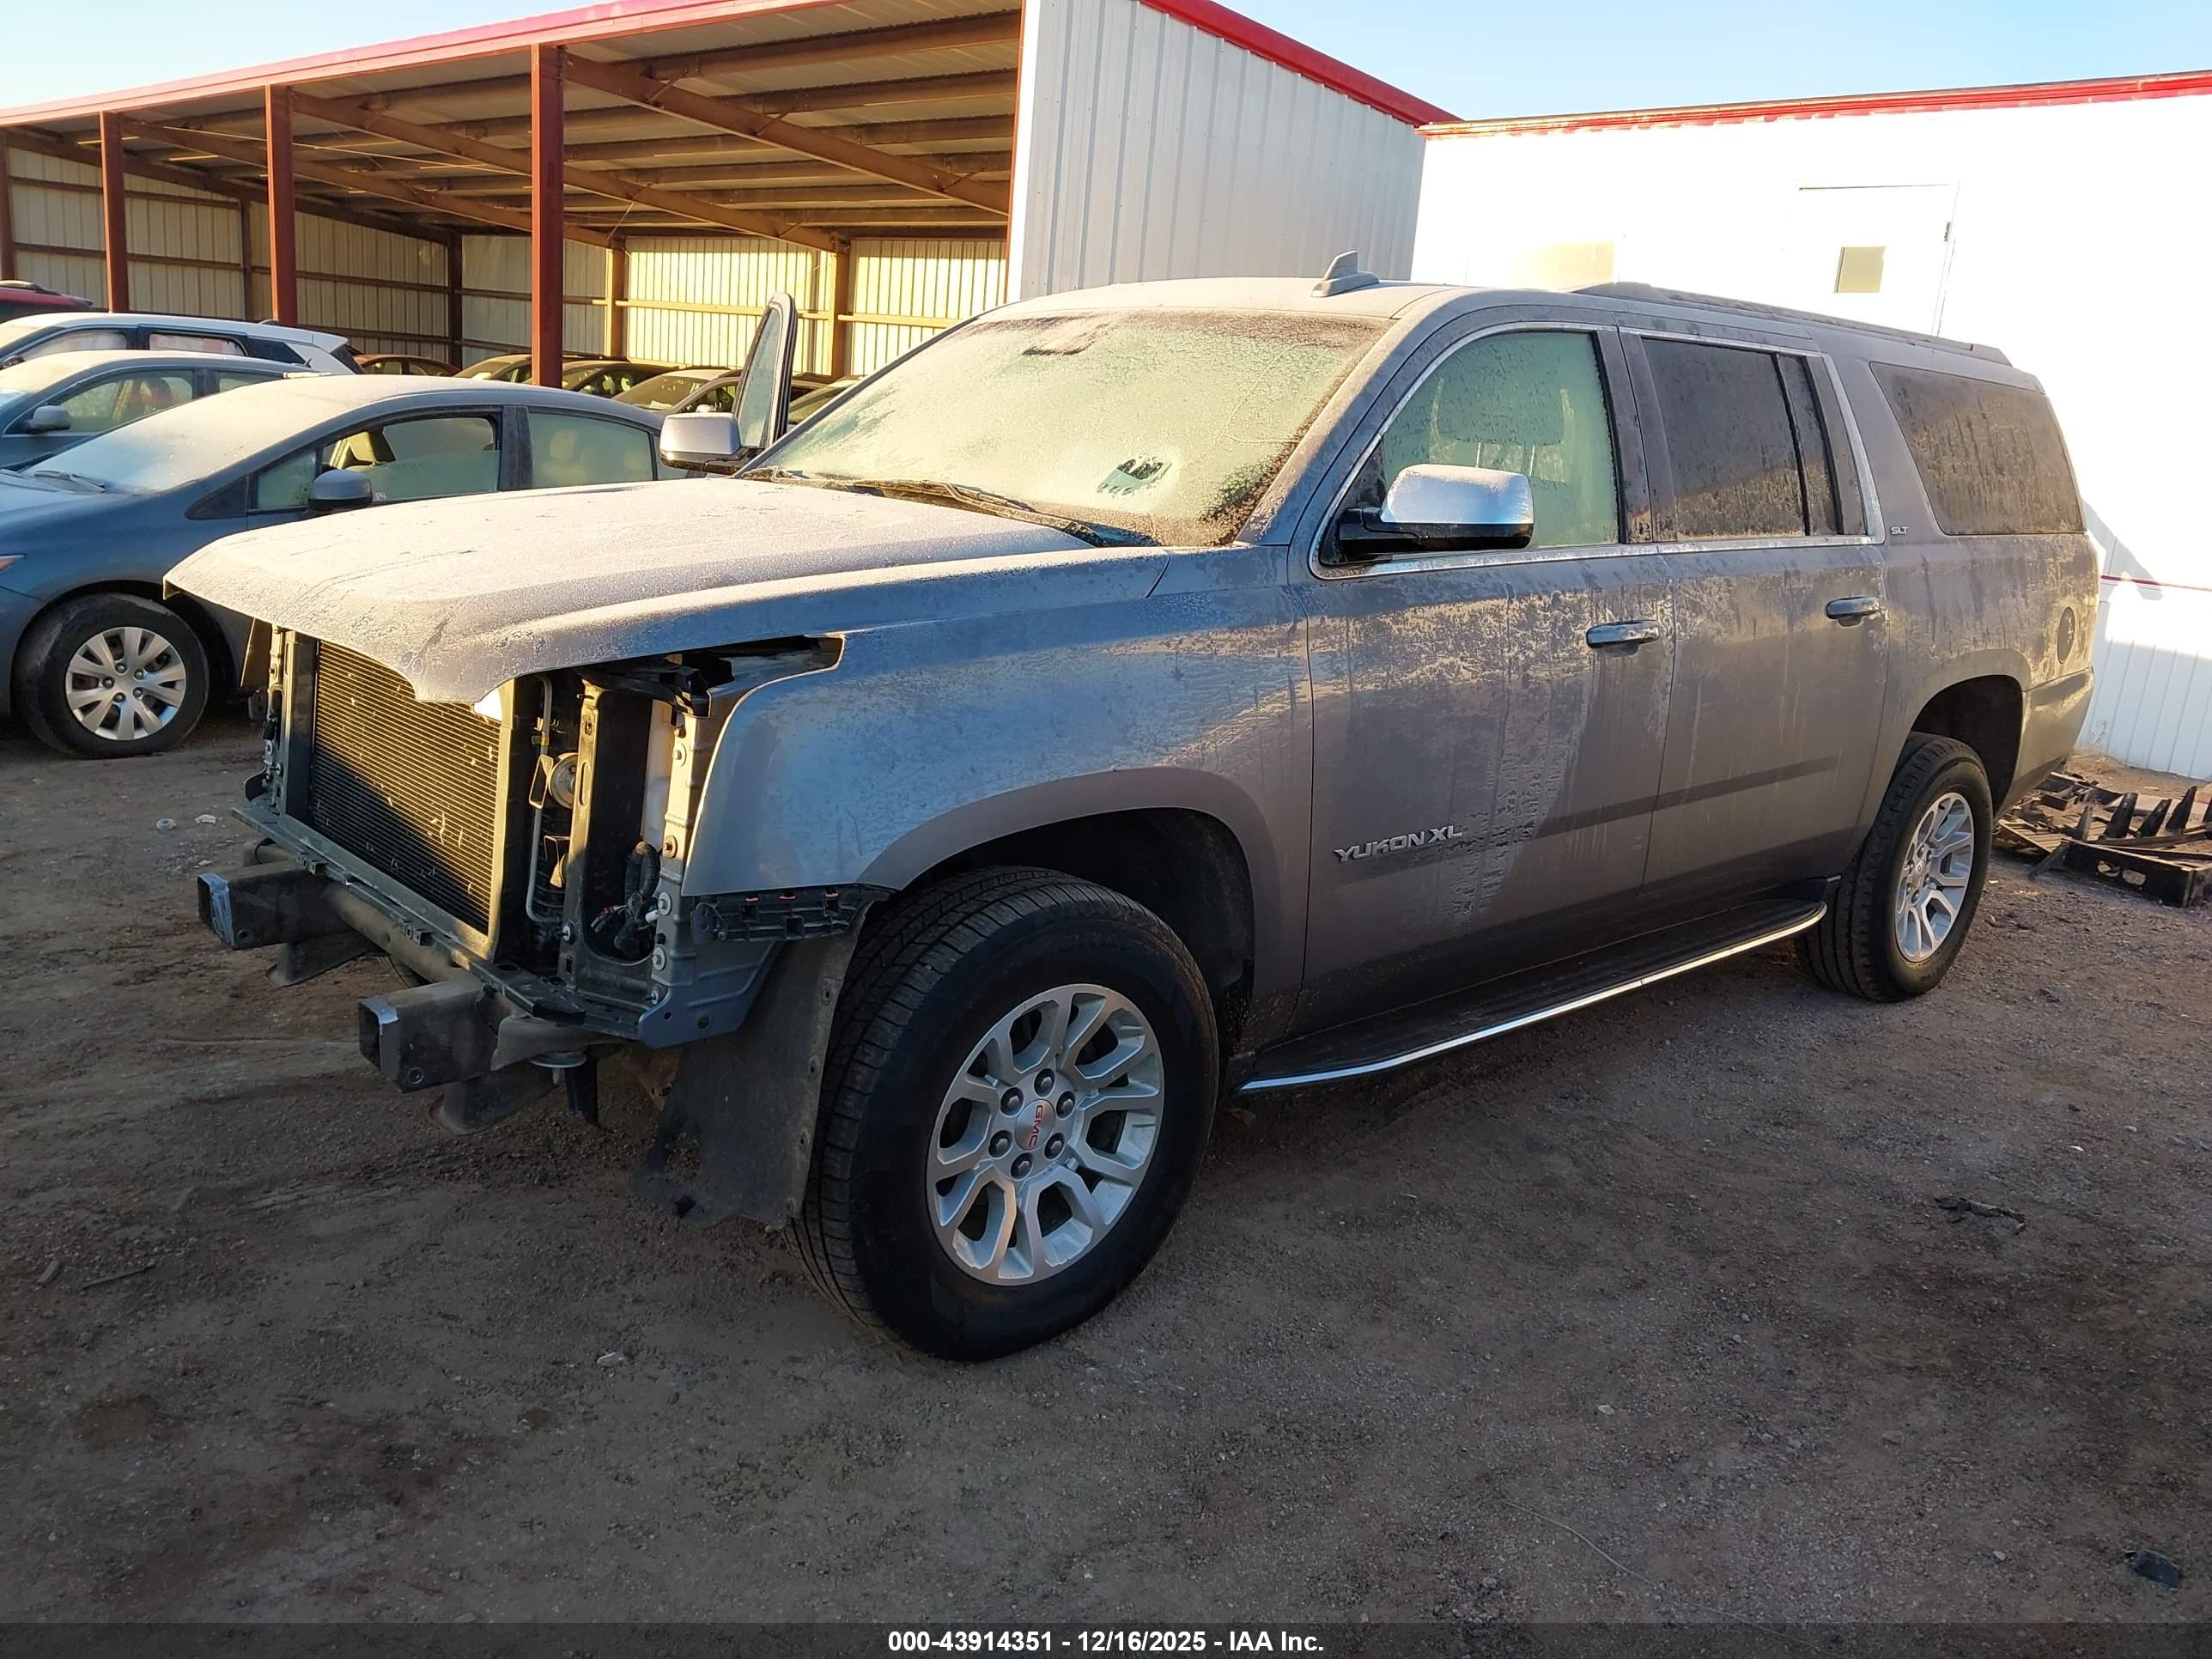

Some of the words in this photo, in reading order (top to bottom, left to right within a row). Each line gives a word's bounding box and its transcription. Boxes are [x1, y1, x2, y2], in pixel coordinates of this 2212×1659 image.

[1890, 526, 1909, 535] SLT
[1334, 830, 1425, 862] YUKON
[1427, 824, 1463, 844] XL
[1029, 1104, 1044, 1147] GMC
